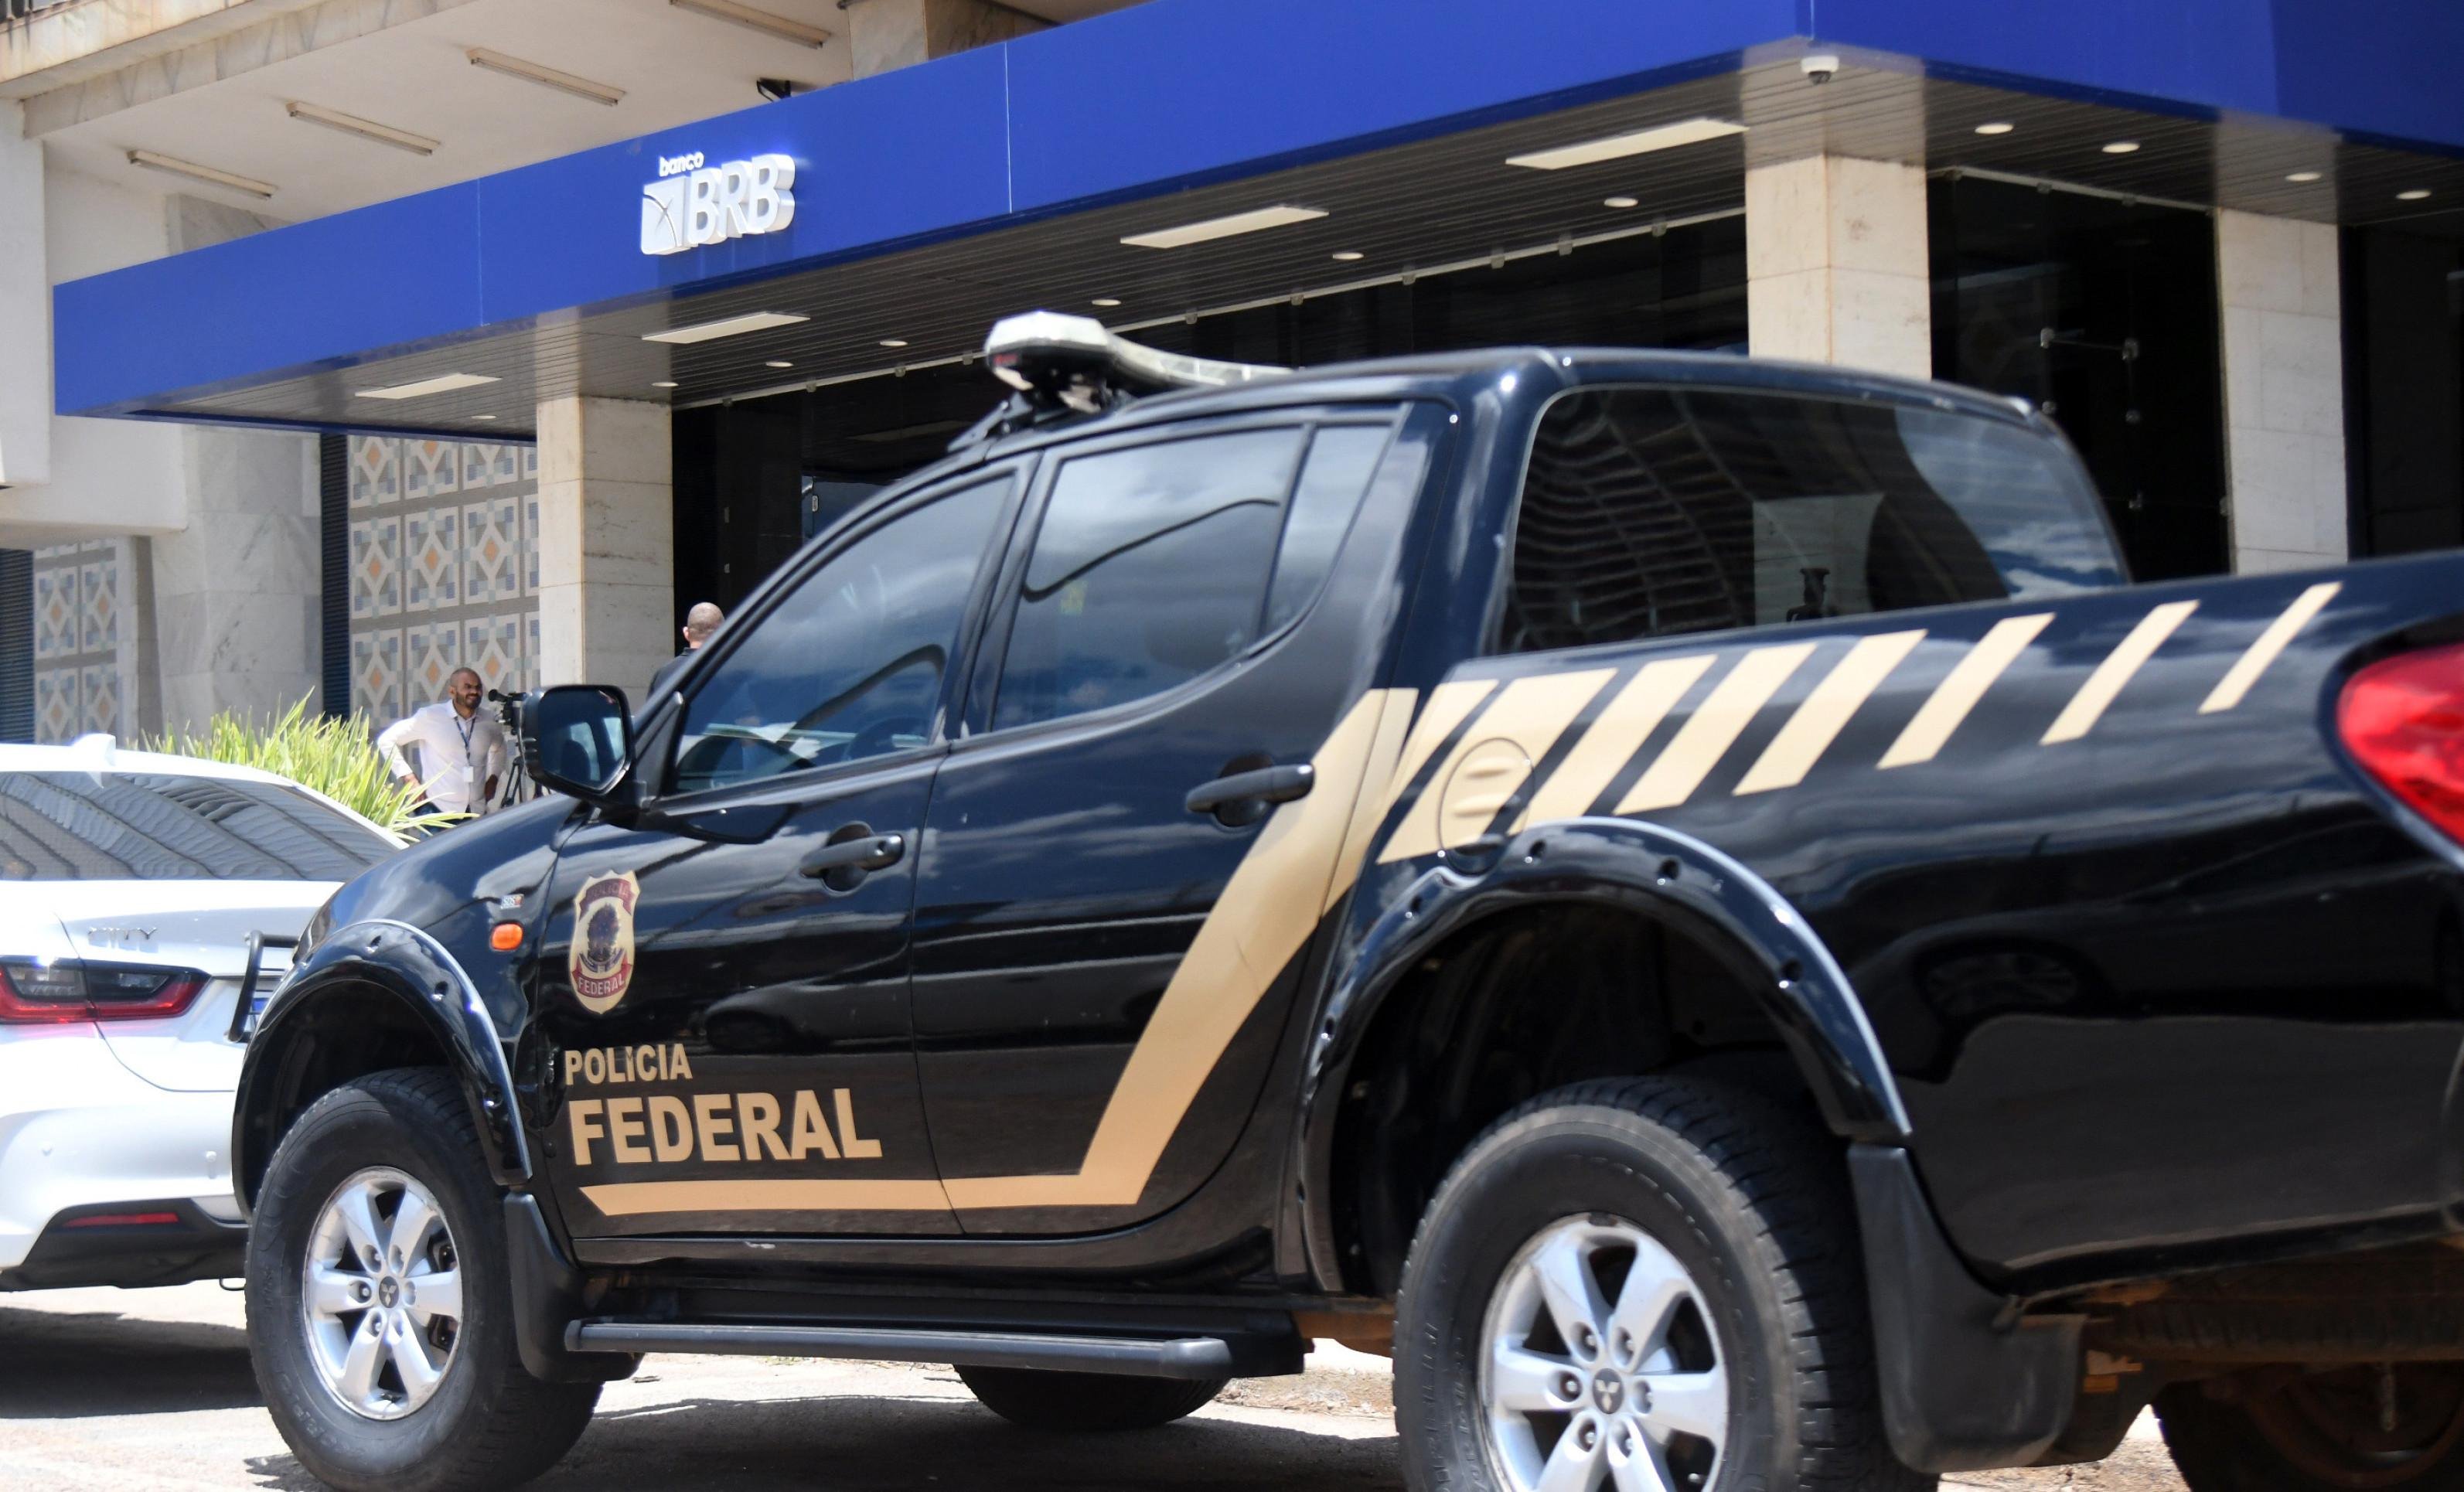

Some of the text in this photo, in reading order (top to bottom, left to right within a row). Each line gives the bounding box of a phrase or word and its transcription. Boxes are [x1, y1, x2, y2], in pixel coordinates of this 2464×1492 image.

[659, 152, 704, 177] banco
[687, 154, 796, 245] BRB
[578, 973, 625, 996] FEDERAL
[568, 1088, 883, 1166] FEDERAL
